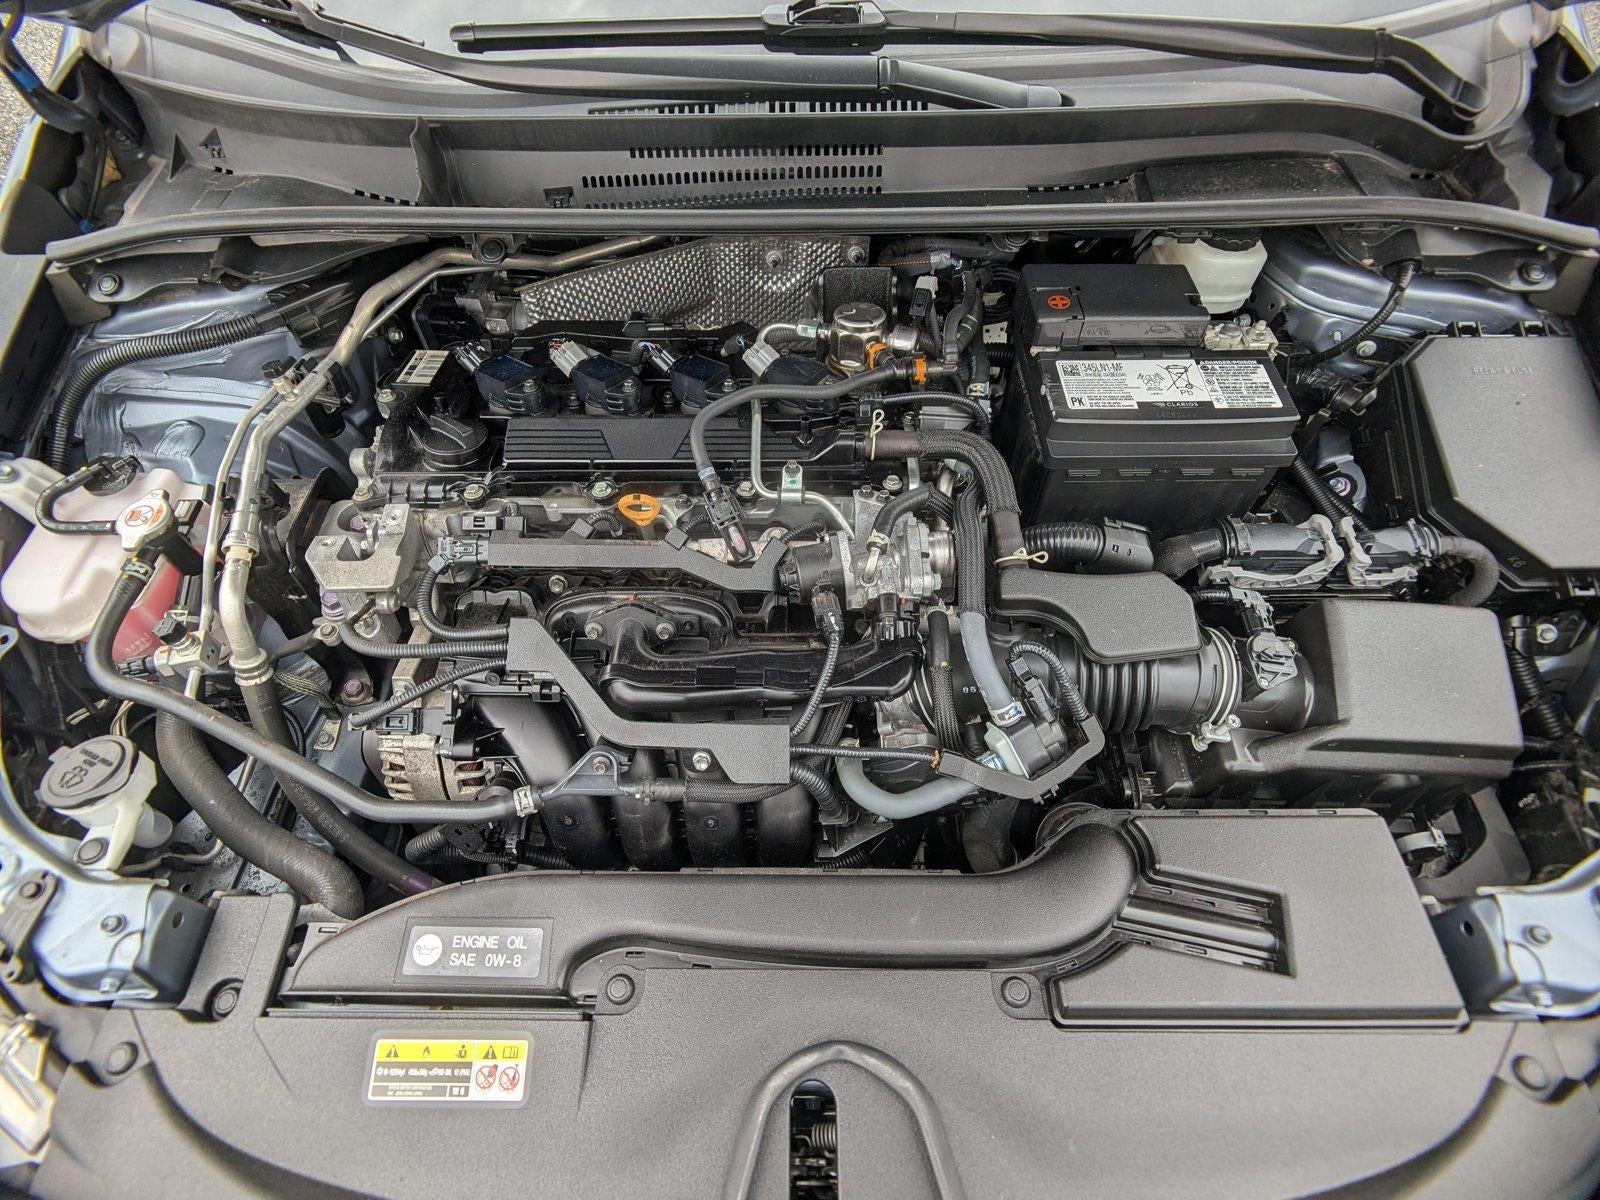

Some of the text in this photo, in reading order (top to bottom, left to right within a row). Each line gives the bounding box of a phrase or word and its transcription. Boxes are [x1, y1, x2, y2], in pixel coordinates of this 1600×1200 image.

[1081, 362, 1123, 373] 345LN1-MF
[1070, 396, 1085, 407] PK
[452, 935, 528, 950] ENGINE OIL
[449, 952, 522, 968] SAE 0W-8
